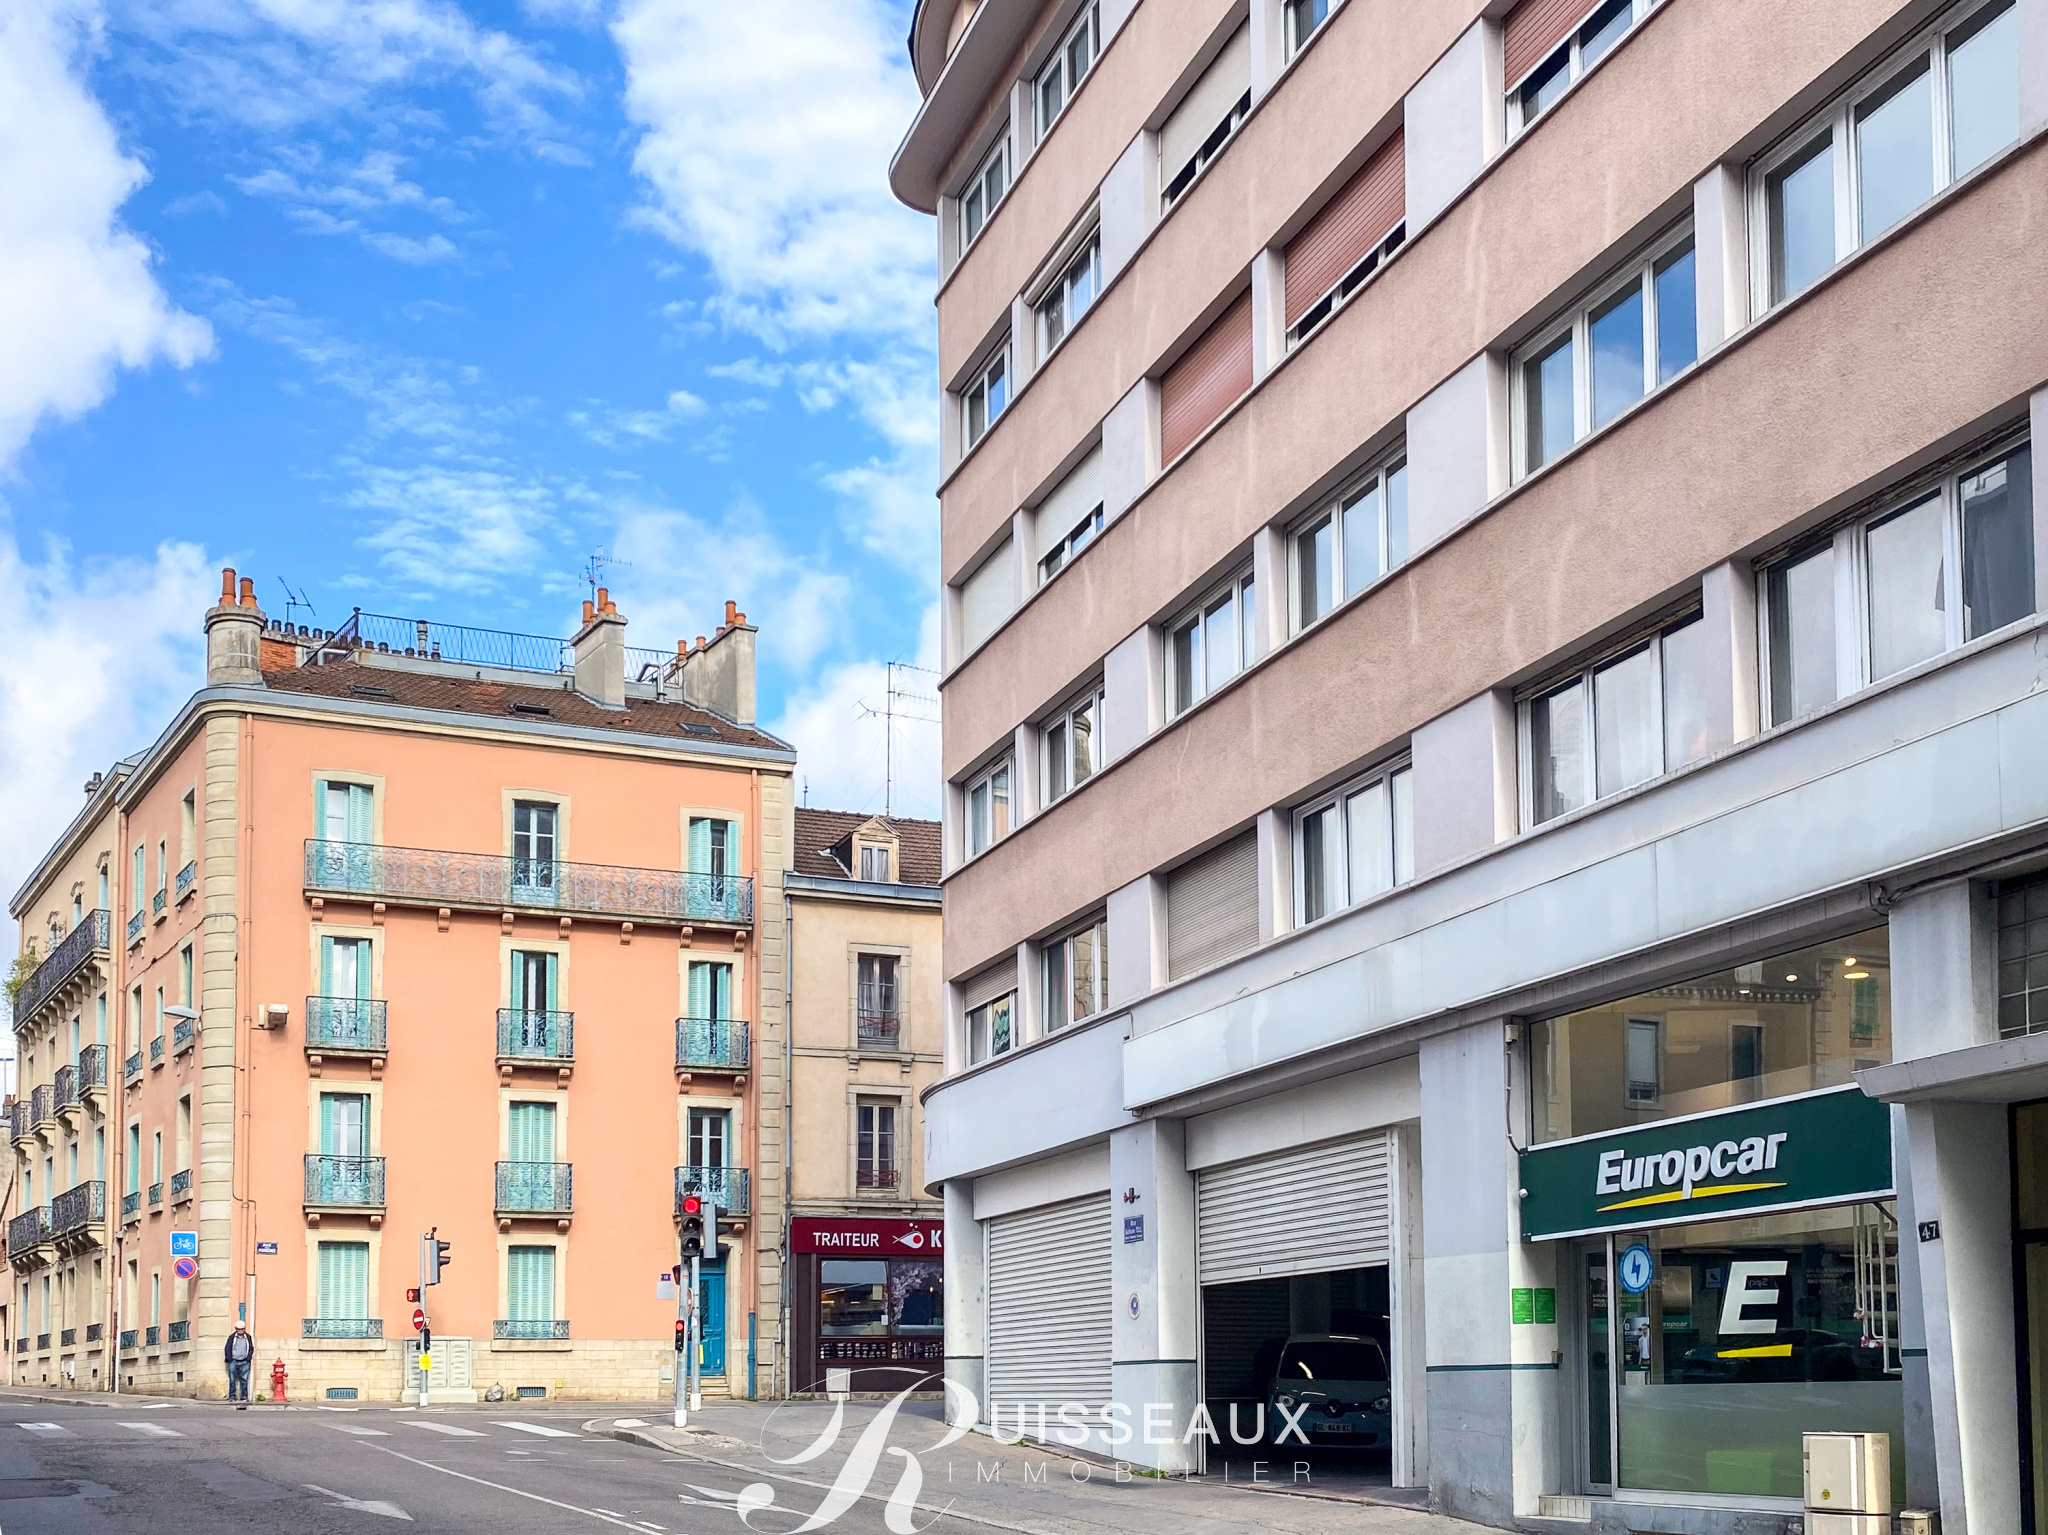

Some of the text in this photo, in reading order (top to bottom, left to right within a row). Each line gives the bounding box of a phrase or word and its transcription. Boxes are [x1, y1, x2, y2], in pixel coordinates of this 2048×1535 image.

[1596, 1132, 1788, 1200] Europcar
[812, 1231, 880, 1247] TRAITEUR
[1921, 1223, 1937, 1240] 47
[1718, 1260, 1789, 1335] E
